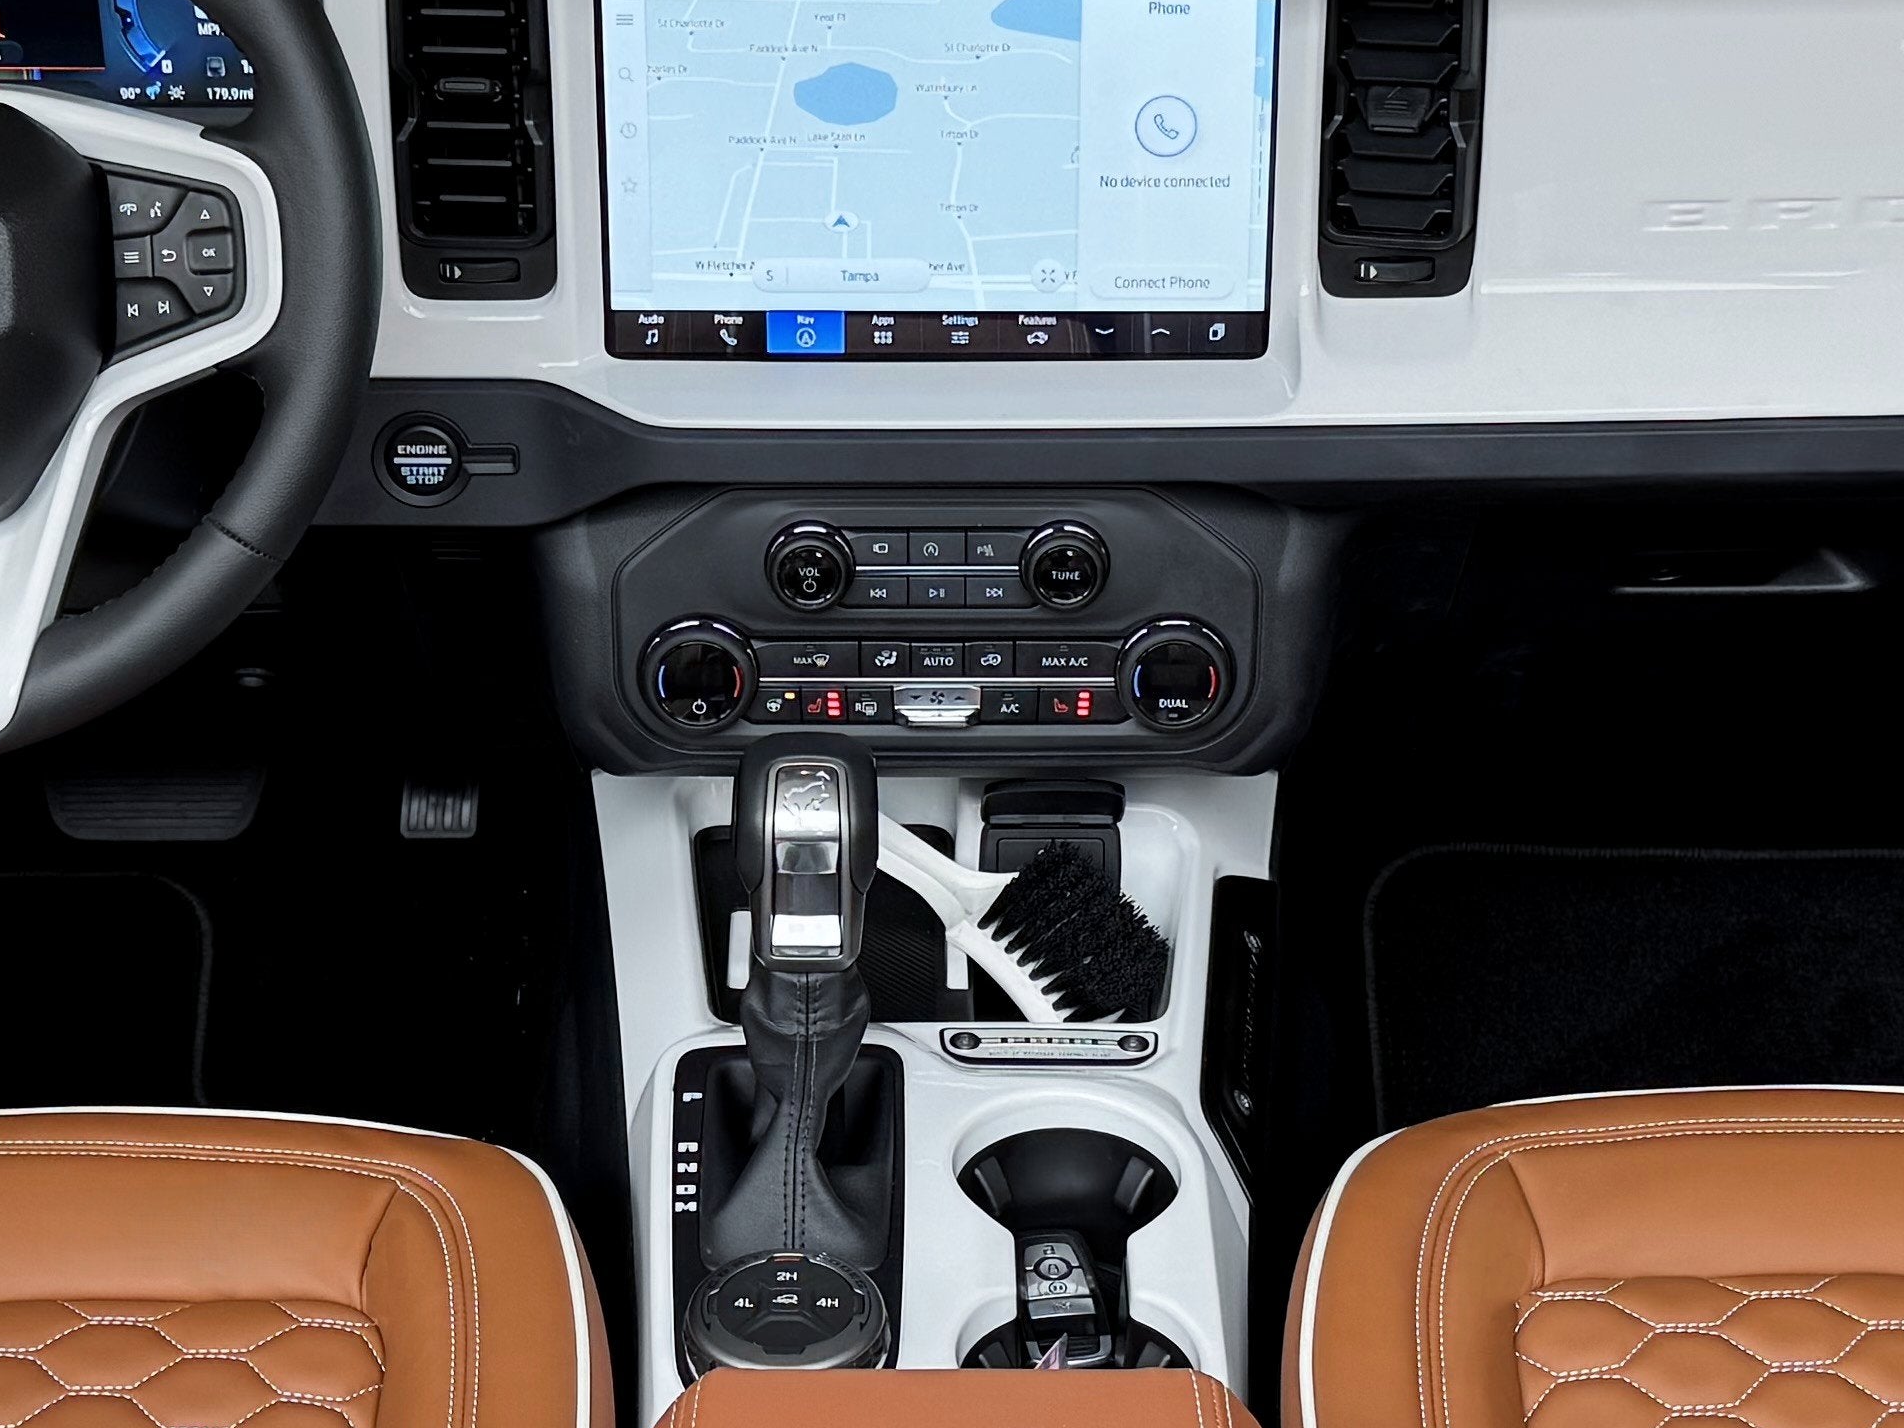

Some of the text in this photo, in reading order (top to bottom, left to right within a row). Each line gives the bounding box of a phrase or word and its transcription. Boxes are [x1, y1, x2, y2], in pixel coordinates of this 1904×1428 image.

[1148, 1, 1191, 15] Phone
[956, 43, 999, 52] Charlotte
[1002, 43, 1011, 52] Dr
[161, 59, 173, 73] 0
[1099, 175, 1231, 188] No device connected
[202, 248, 216, 257] OK
[766, 270, 880, 283] S Tampa
[1114, 276, 1210, 289] Connect Phone
[638, 314, 664, 325] Audio
[714, 315, 743, 325] Phone
[797, 315, 815, 324] Nav
[871, 315, 895, 326] Apps
[942, 315, 979, 326] Settings
[1018, 315, 1057, 326] Features
[397, 445, 447, 455] ENGINE
[401, 466, 446, 476] START
[406, 475, 443, 485] STOP
[798, 568, 820, 577] VOL
[1052, 570, 1081, 581] TUNE
[793, 657, 812, 665] MAX
[923, 656, 954, 667] AUTO
[1041, 656, 1089, 667] MAX A/C
[1000, 703, 1020, 714] A/C
[1159, 698, 1189, 709] DUAL
[777, 1272, 797, 1281] 2H
[734, 1298, 754, 1308] 4L
[816, 1298, 839, 1308] 4H
